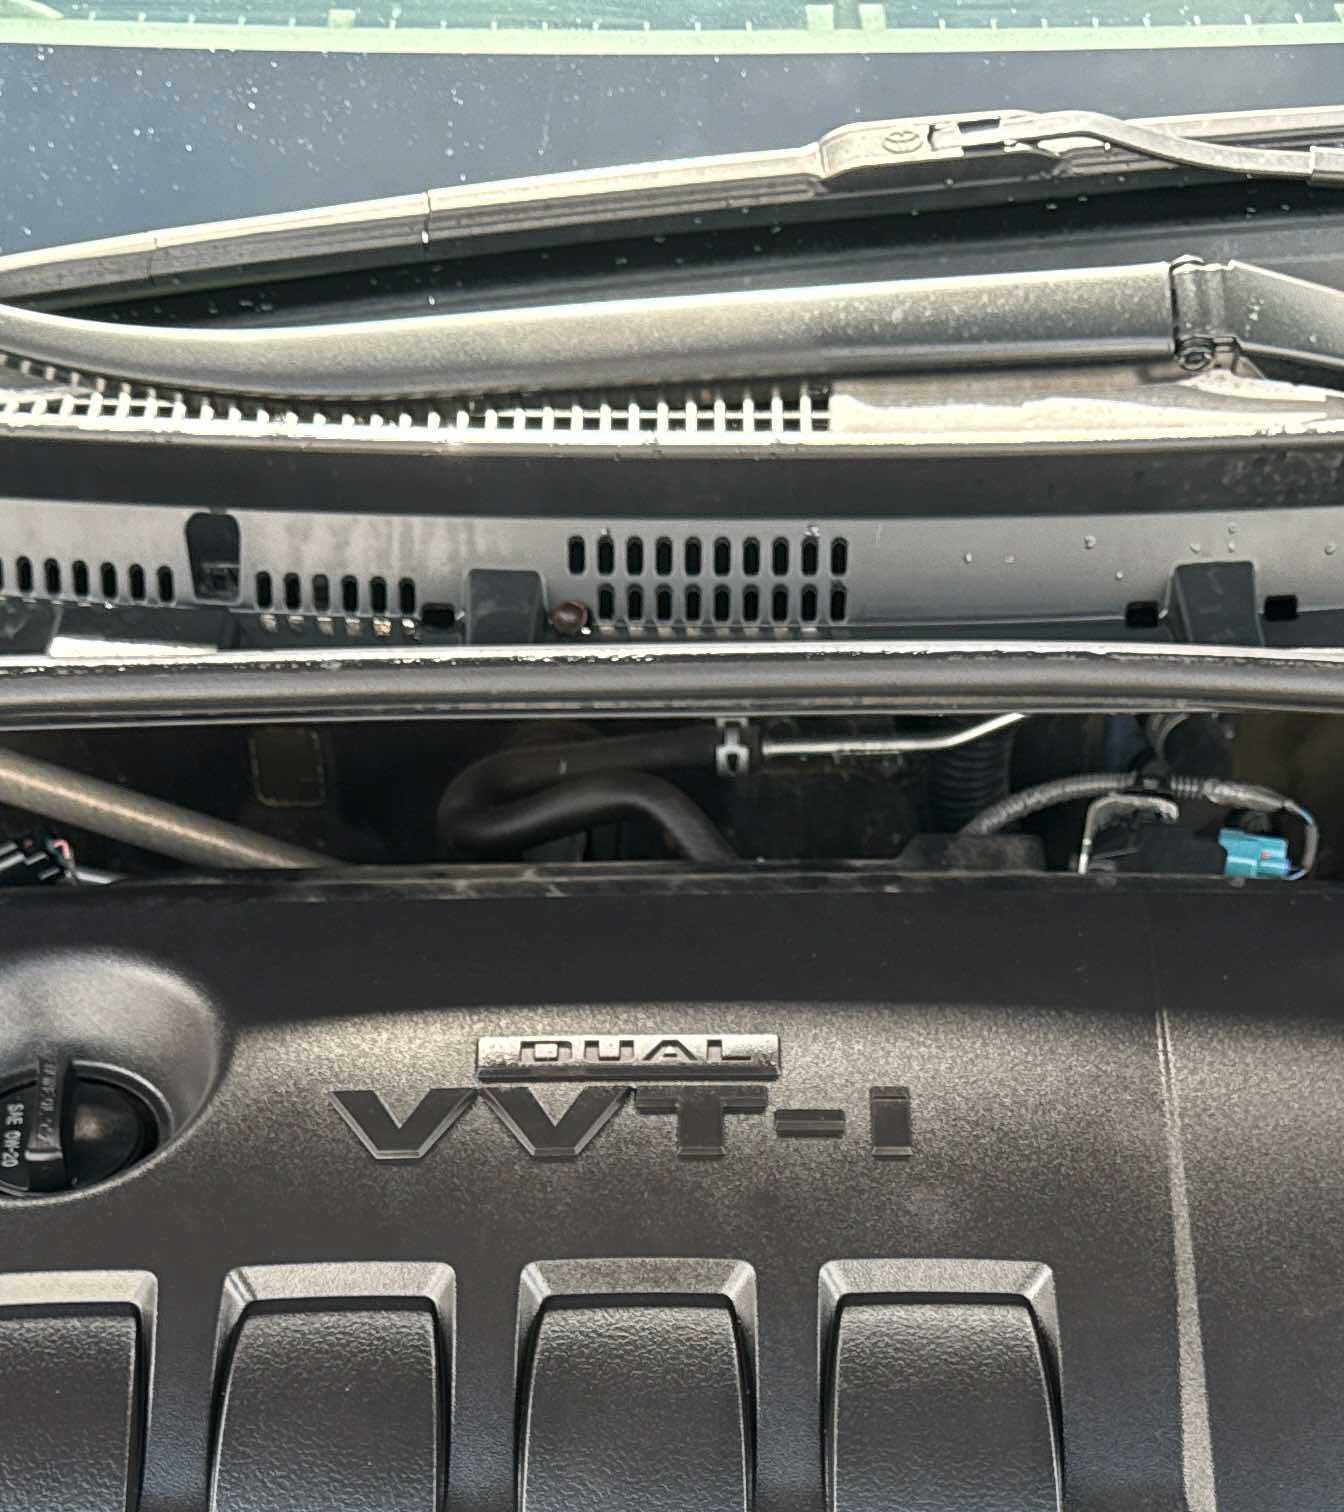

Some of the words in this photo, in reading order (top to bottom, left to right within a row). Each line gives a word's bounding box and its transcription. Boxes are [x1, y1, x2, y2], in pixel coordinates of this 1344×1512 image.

[519, 1038, 752, 1062] DUAL
[6, 1103, 24, 1126] SAE
[0, 1130, 22, 1168] 0W-20
